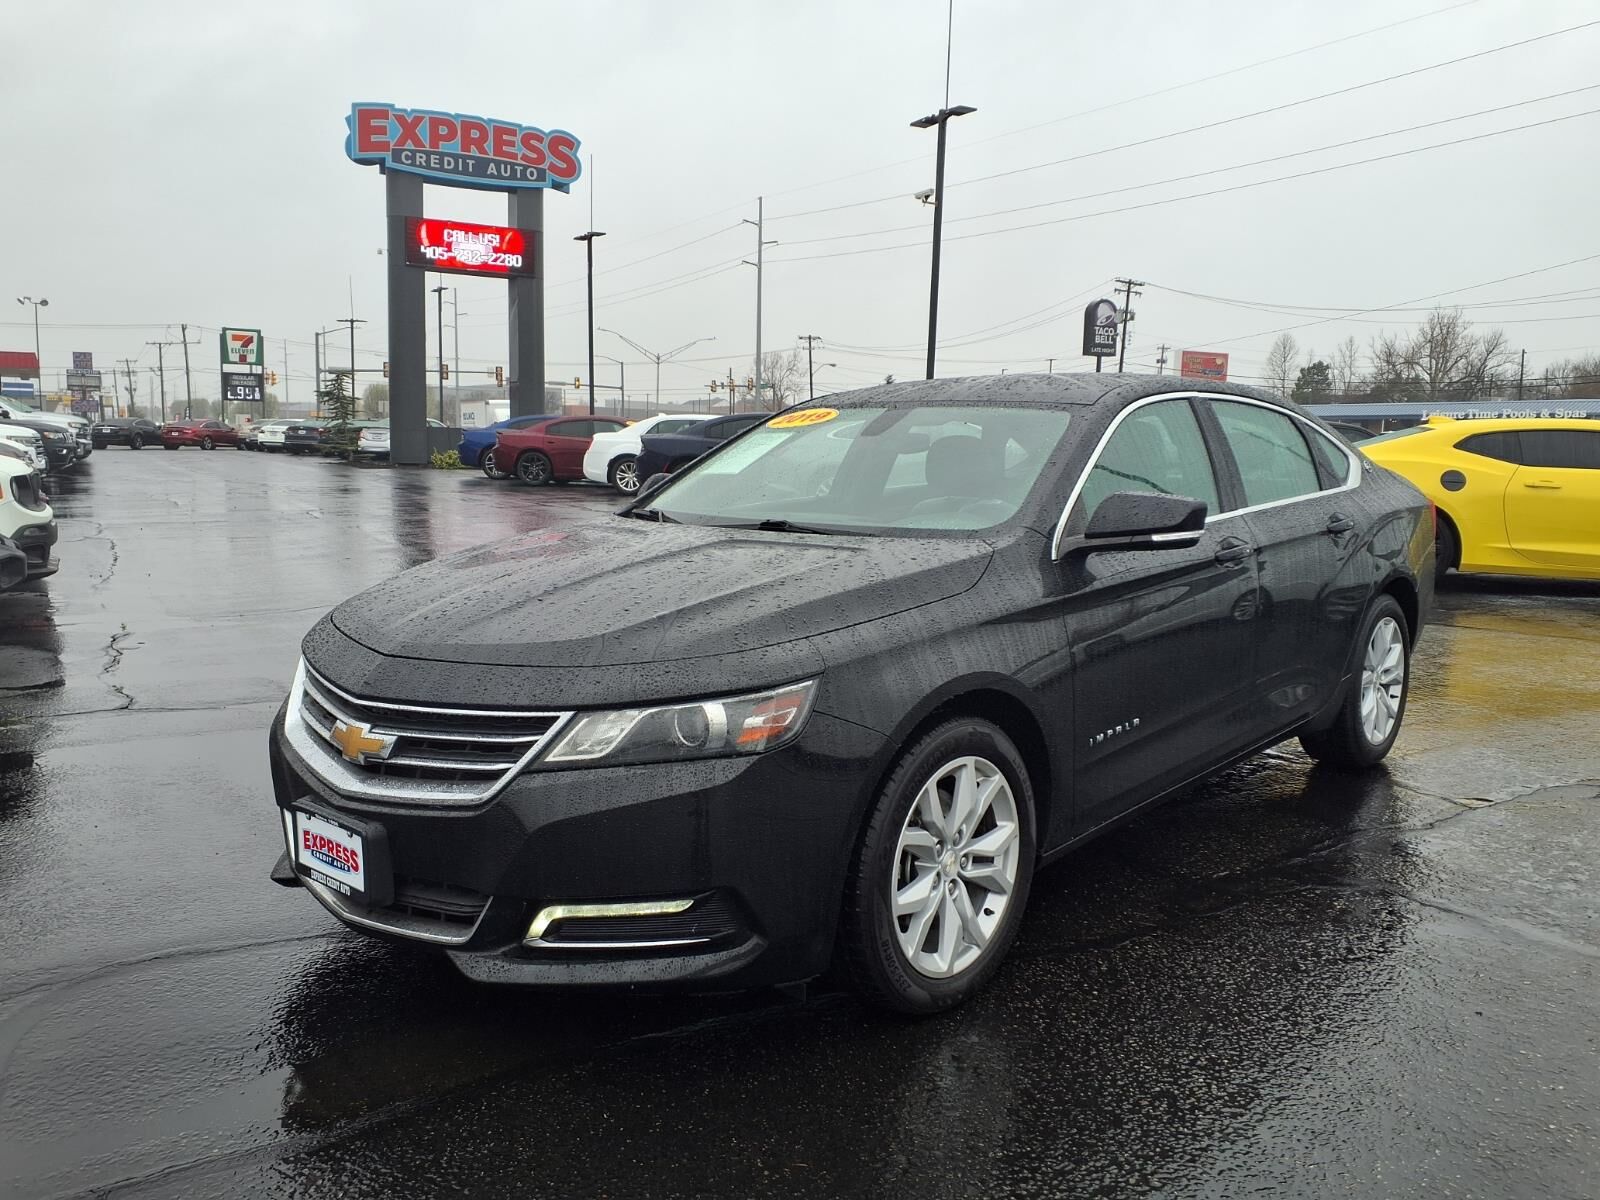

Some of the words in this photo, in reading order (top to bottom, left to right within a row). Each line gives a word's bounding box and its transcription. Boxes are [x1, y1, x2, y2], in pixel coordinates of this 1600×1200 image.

[357, 108, 577, 179] EXPRESS
[401, 151, 476, 172] CREDIT
[487, 162, 538, 180] AUTO
[444, 229, 477, 244] CALL
[479, 233, 501, 247] US!
[1094, 326, 1115, 336] TACO
[1095, 335, 1114, 344] BELL
[770, 411, 833, 426] 2019
[1467, 409, 1498, 419] Time
[1502, 408, 1535, 419] Pools
[1540, 408, 1551, 418] &
[1554, 408, 1588, 419] Spas
[1089, 717, 1140, 747] IMPALA
[303, 830, 359, 873] EXPRESS
[313, 850, 332, 864] CREDIT
[333, 860, 349, 871] AUTO
